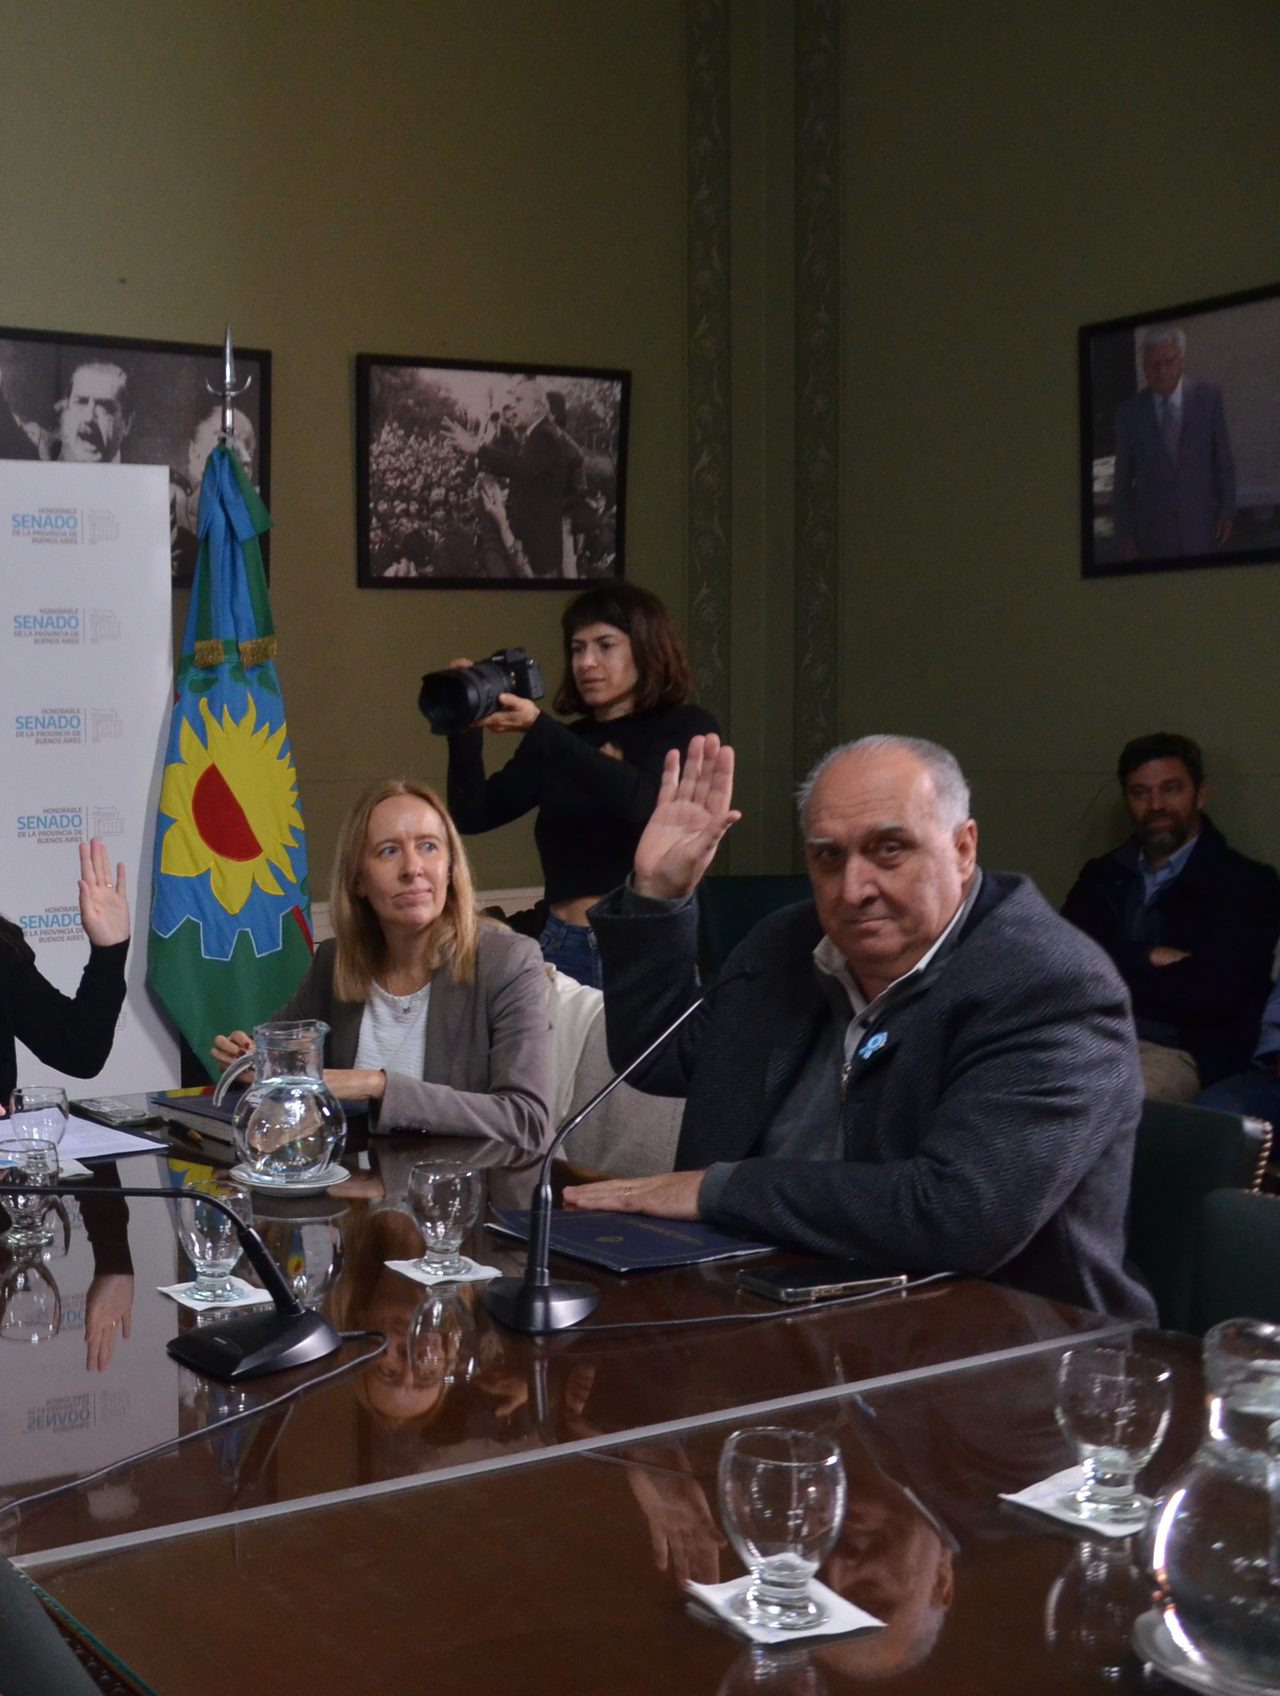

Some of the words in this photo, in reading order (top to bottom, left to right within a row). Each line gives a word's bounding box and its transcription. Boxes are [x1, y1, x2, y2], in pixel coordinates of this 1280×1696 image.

[11, 513, 77, 530] SENADO
[13, 614, 79, 630] SENADO
[15, 715, 81, 730] SENADO
[16, 814, 82, 830] SENADO
[38, 829, 73, 837] PROVINCIA
